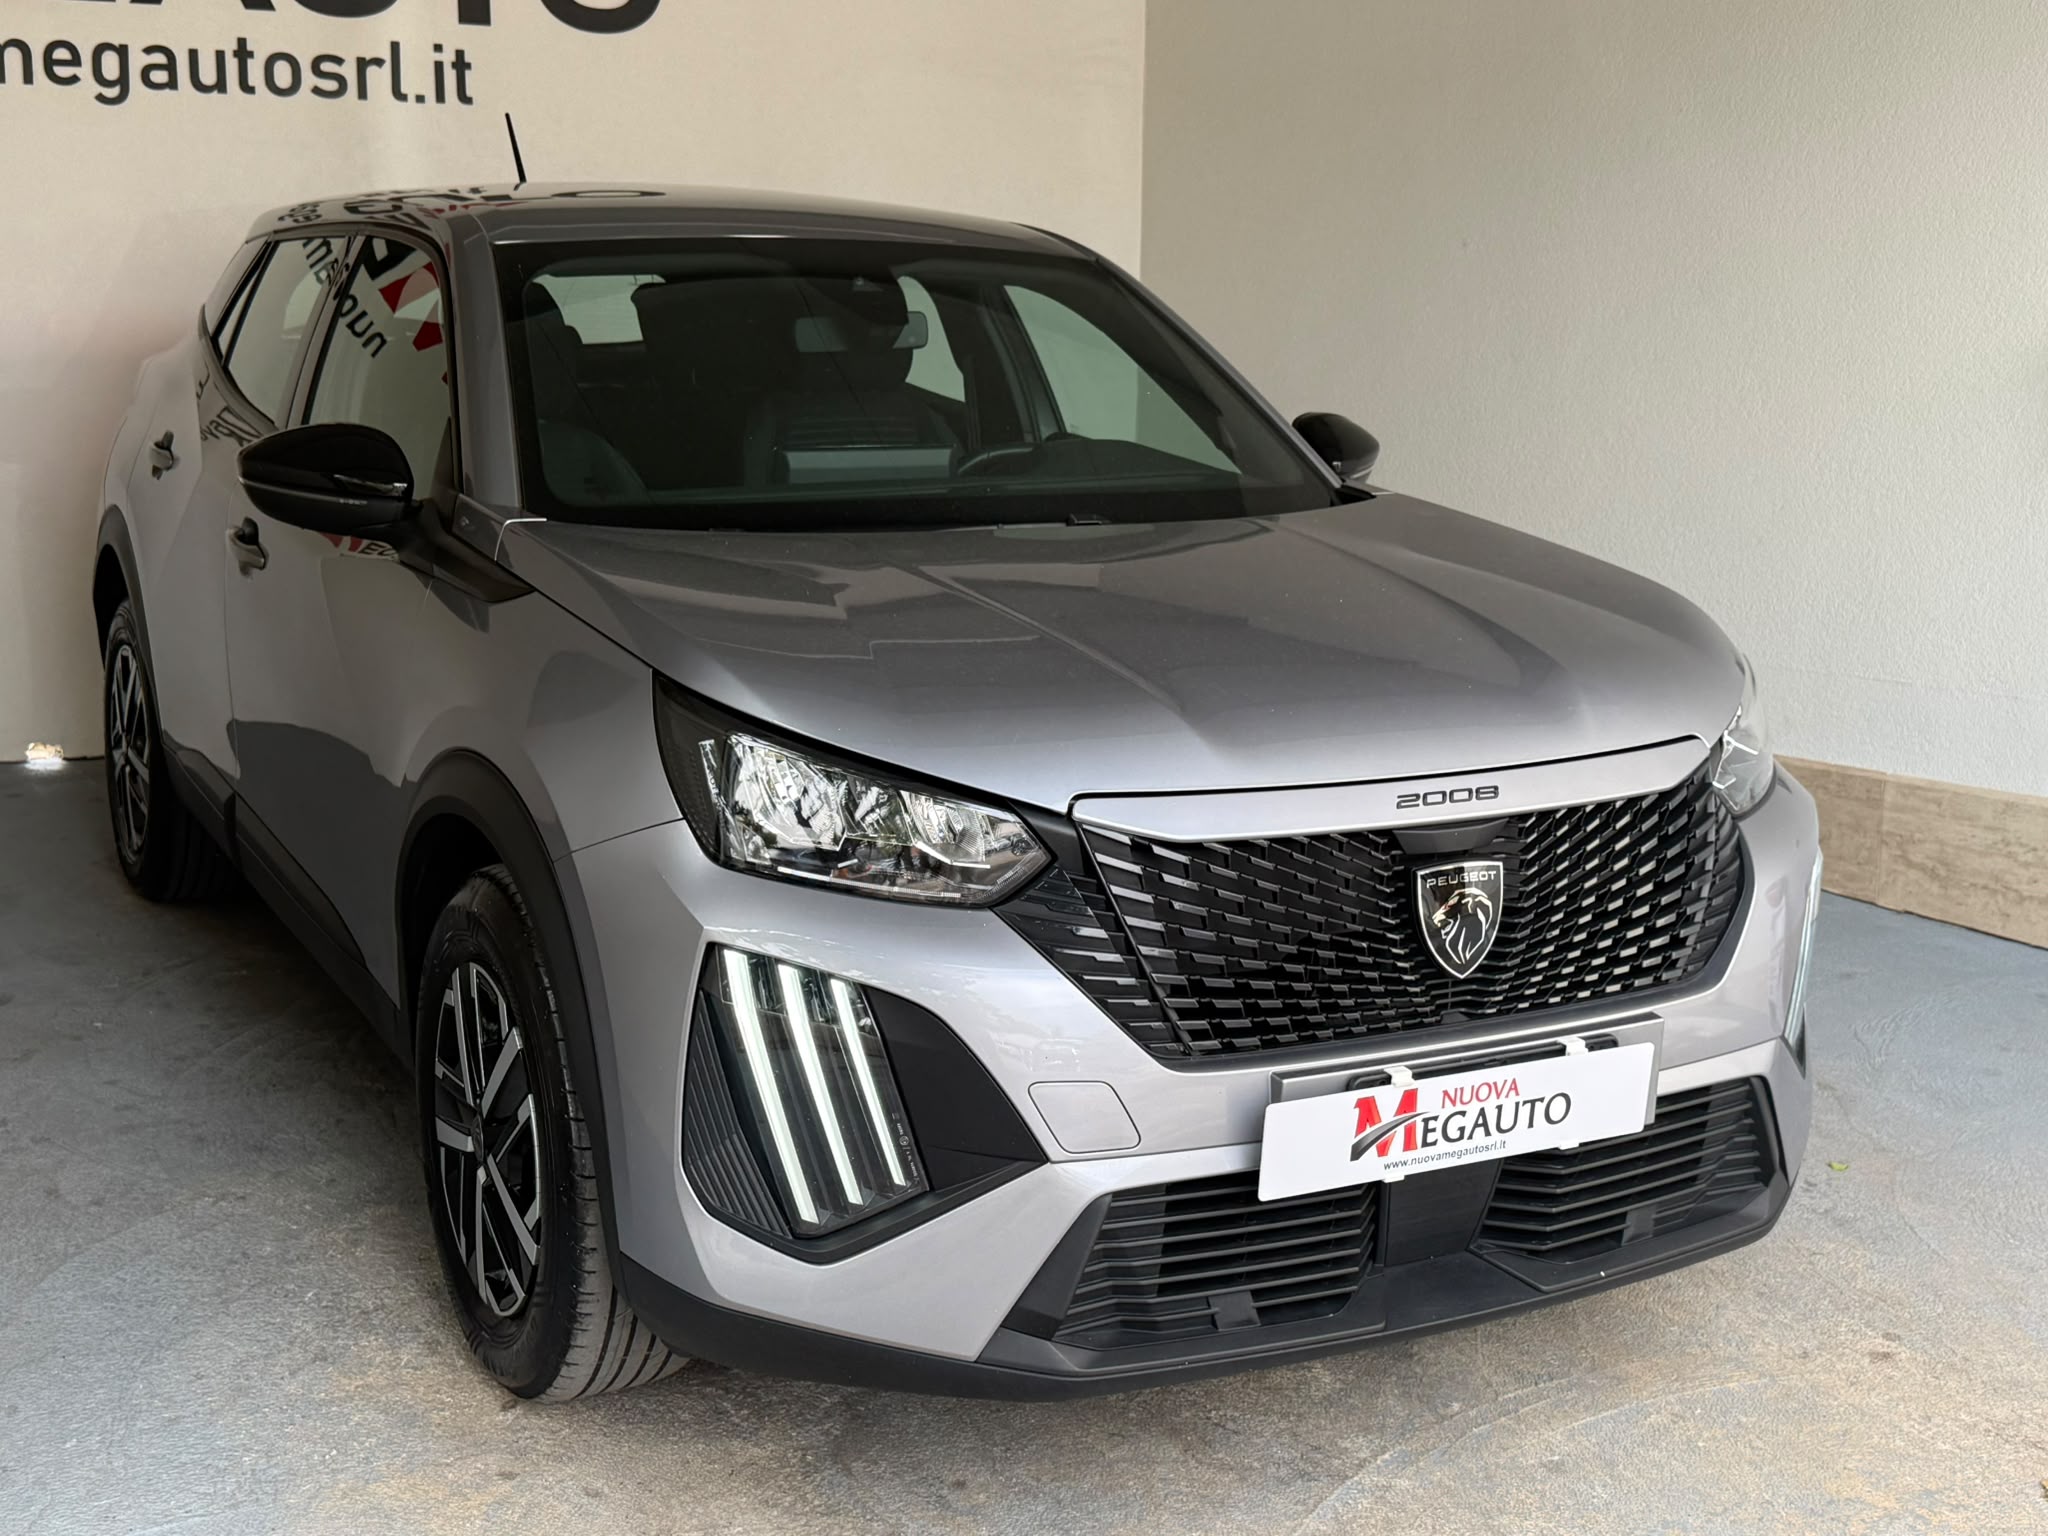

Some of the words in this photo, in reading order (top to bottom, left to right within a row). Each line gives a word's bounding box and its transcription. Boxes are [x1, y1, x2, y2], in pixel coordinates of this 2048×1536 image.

[1396, 785, 1499, 809] 2008
[1426, 871, 1496, 888] PEUGEOT
[1441, 1078, 1520, 1108] NUOVA
[1353, 1088, 1572, 1157] MEGAUTO
[1383, 1139, 1507, 1171] www.nuovamegautosrl.it
